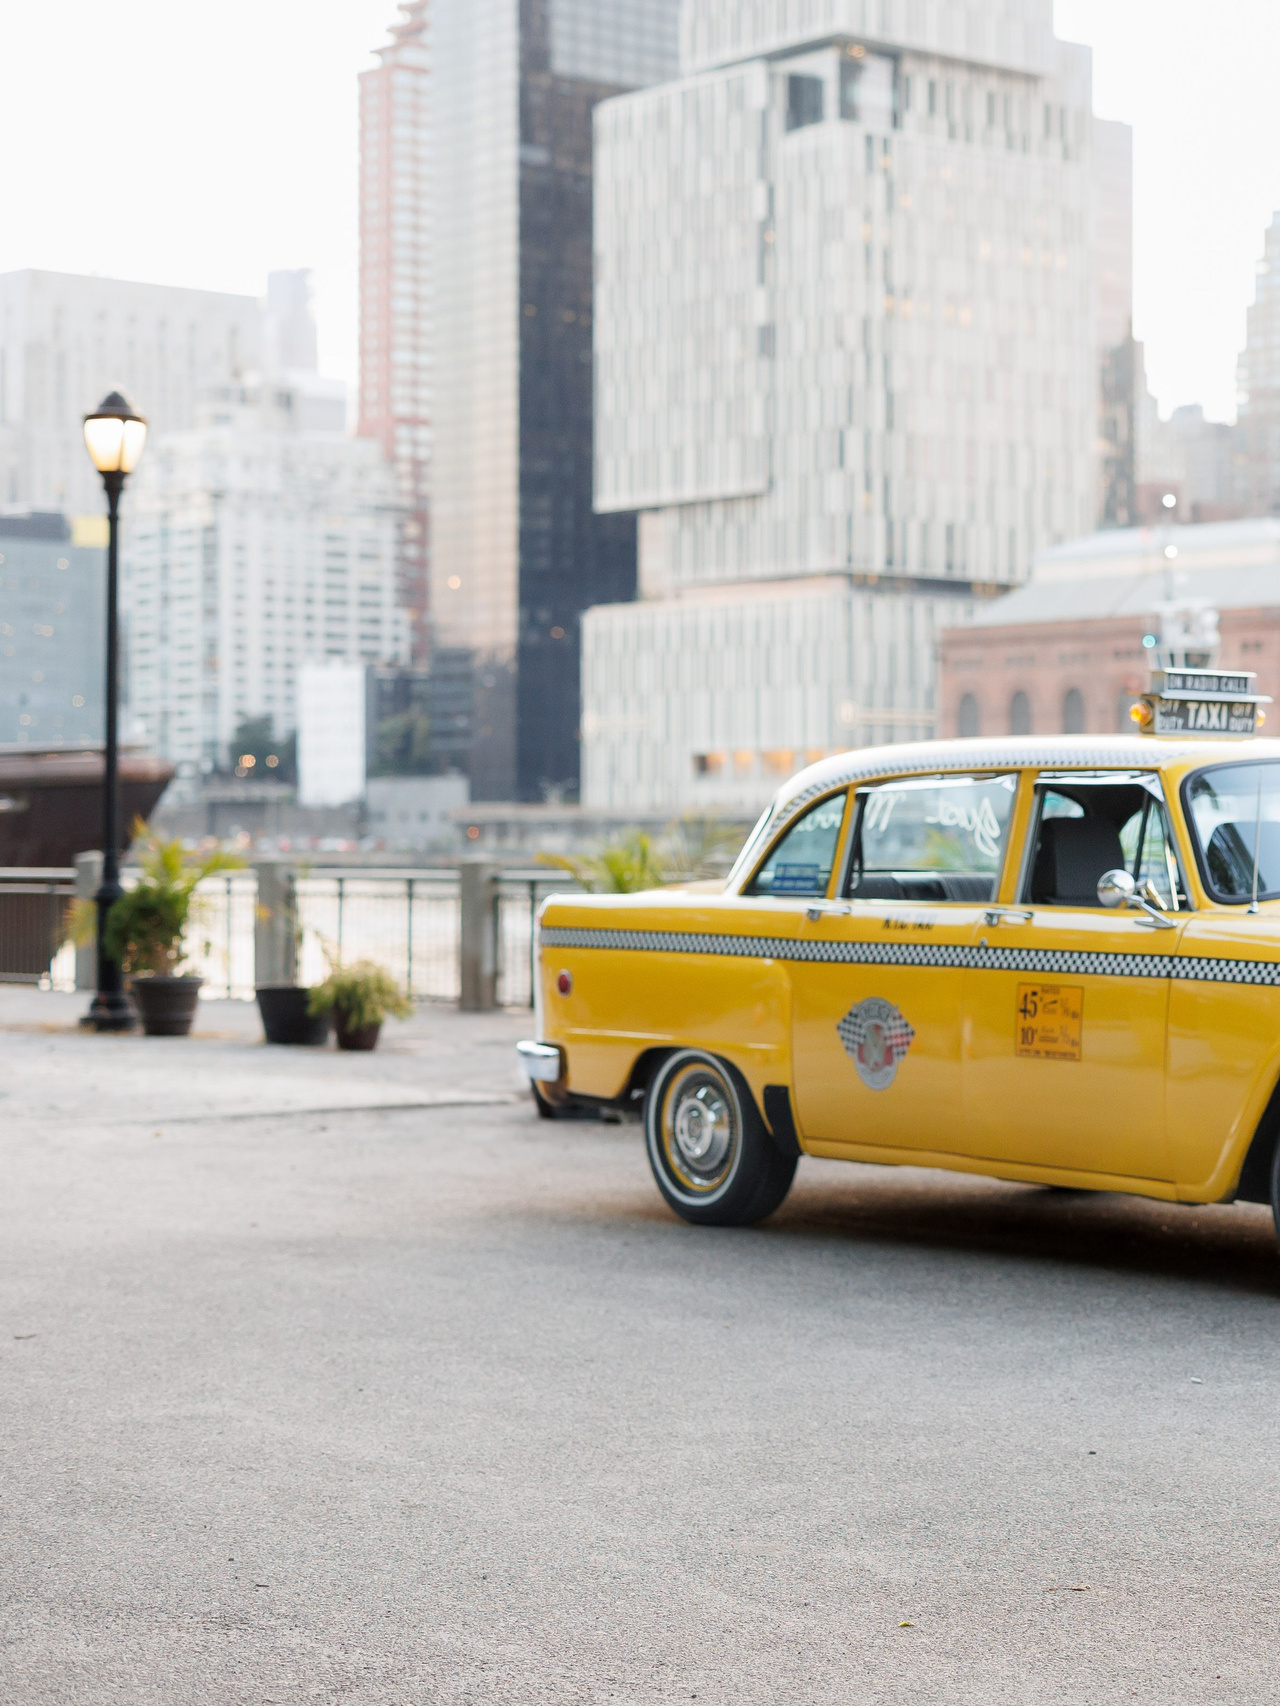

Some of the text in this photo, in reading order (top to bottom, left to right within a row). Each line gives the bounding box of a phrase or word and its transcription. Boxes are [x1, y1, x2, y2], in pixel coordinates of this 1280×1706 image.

[1185, 675, 1219, 692] RADIO
[1220, 677, 1247, 693] CALL
[1186, 701, 1228, 730] TAXI
[1229, 716, 1254, 732] DUTY
